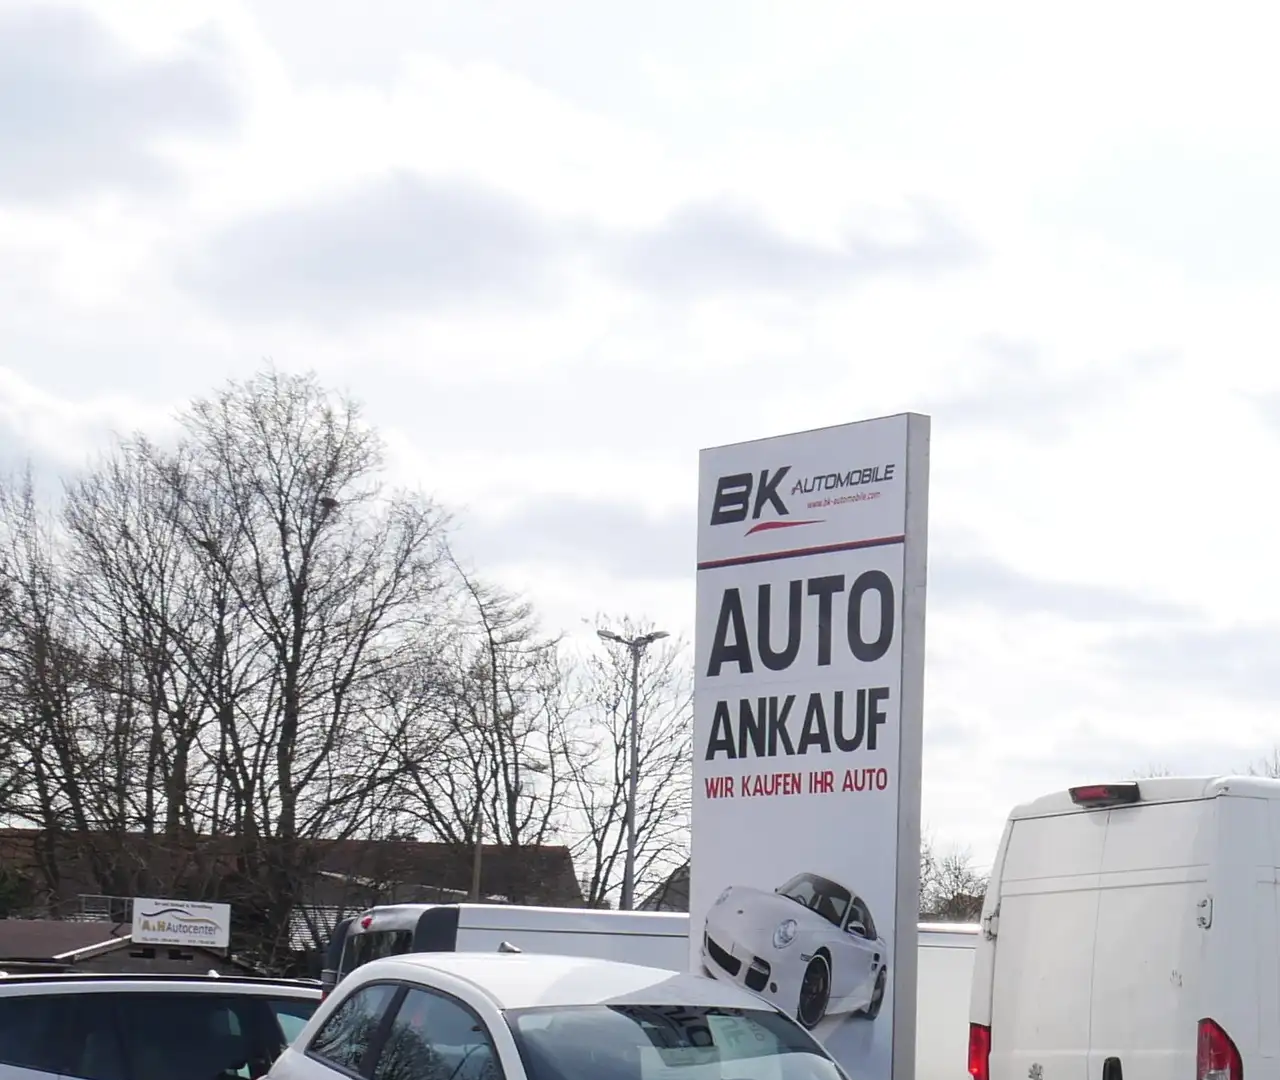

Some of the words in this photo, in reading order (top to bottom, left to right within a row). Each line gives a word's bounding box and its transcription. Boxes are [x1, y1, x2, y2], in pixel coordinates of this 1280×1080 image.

[710, 465, 792, 526] BK
[790, 464, 895, 496] AUTOMOBILE
[706, 569, 895, 677] AUTO
[705, 686, 889, 761] ANKAUF
[705, 776, 734, 799] WIR
[741, 773, 801, 797] KAUFEN
[808, 771, 834, 794] IHR
[842, 768, 888, 792] AUTO
